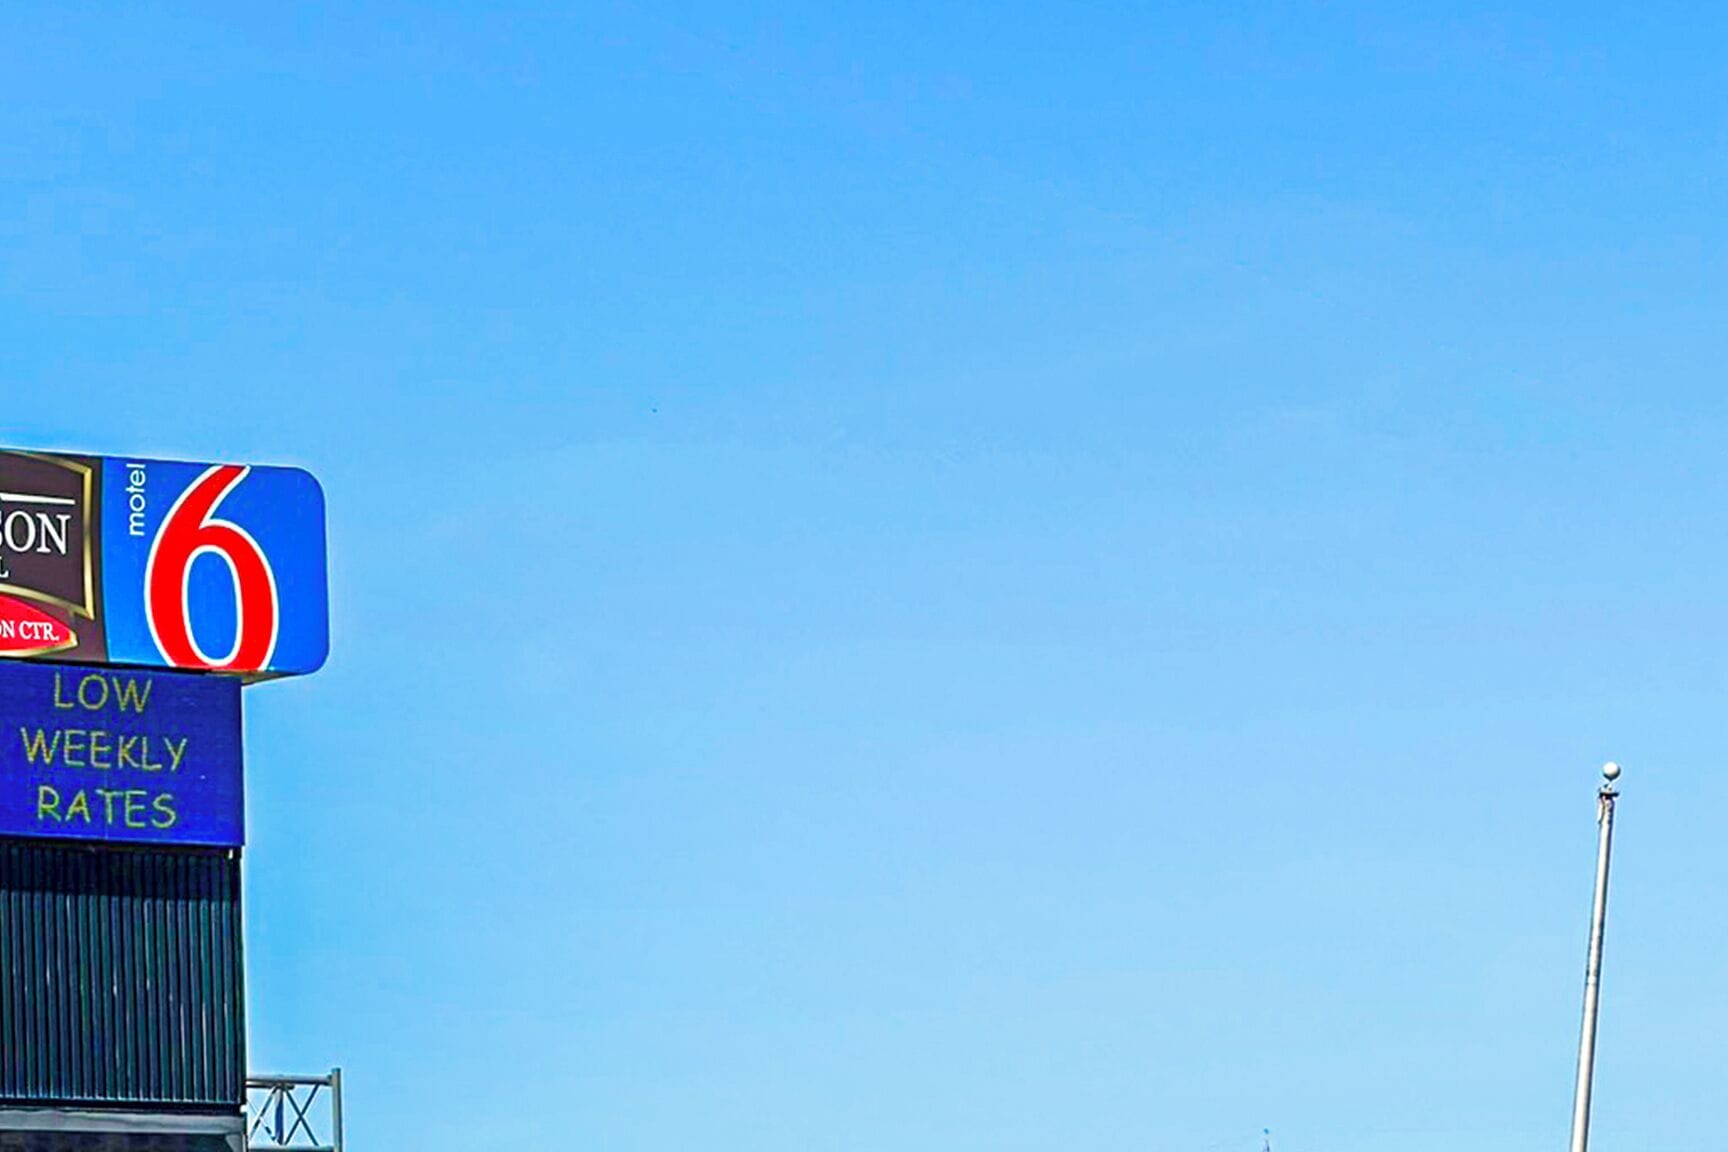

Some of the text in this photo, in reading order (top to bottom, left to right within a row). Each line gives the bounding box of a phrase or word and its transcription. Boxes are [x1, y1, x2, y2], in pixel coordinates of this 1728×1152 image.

[126, 463, 146, 537] motel
[144, 464, 279, 671] 6
[19, 621, 59, 641] CTR.
[54, 672, 152, 713] LOW
[20, 727, 188, 771] WEEKLY
[37, 785, 177, 828] RATES
